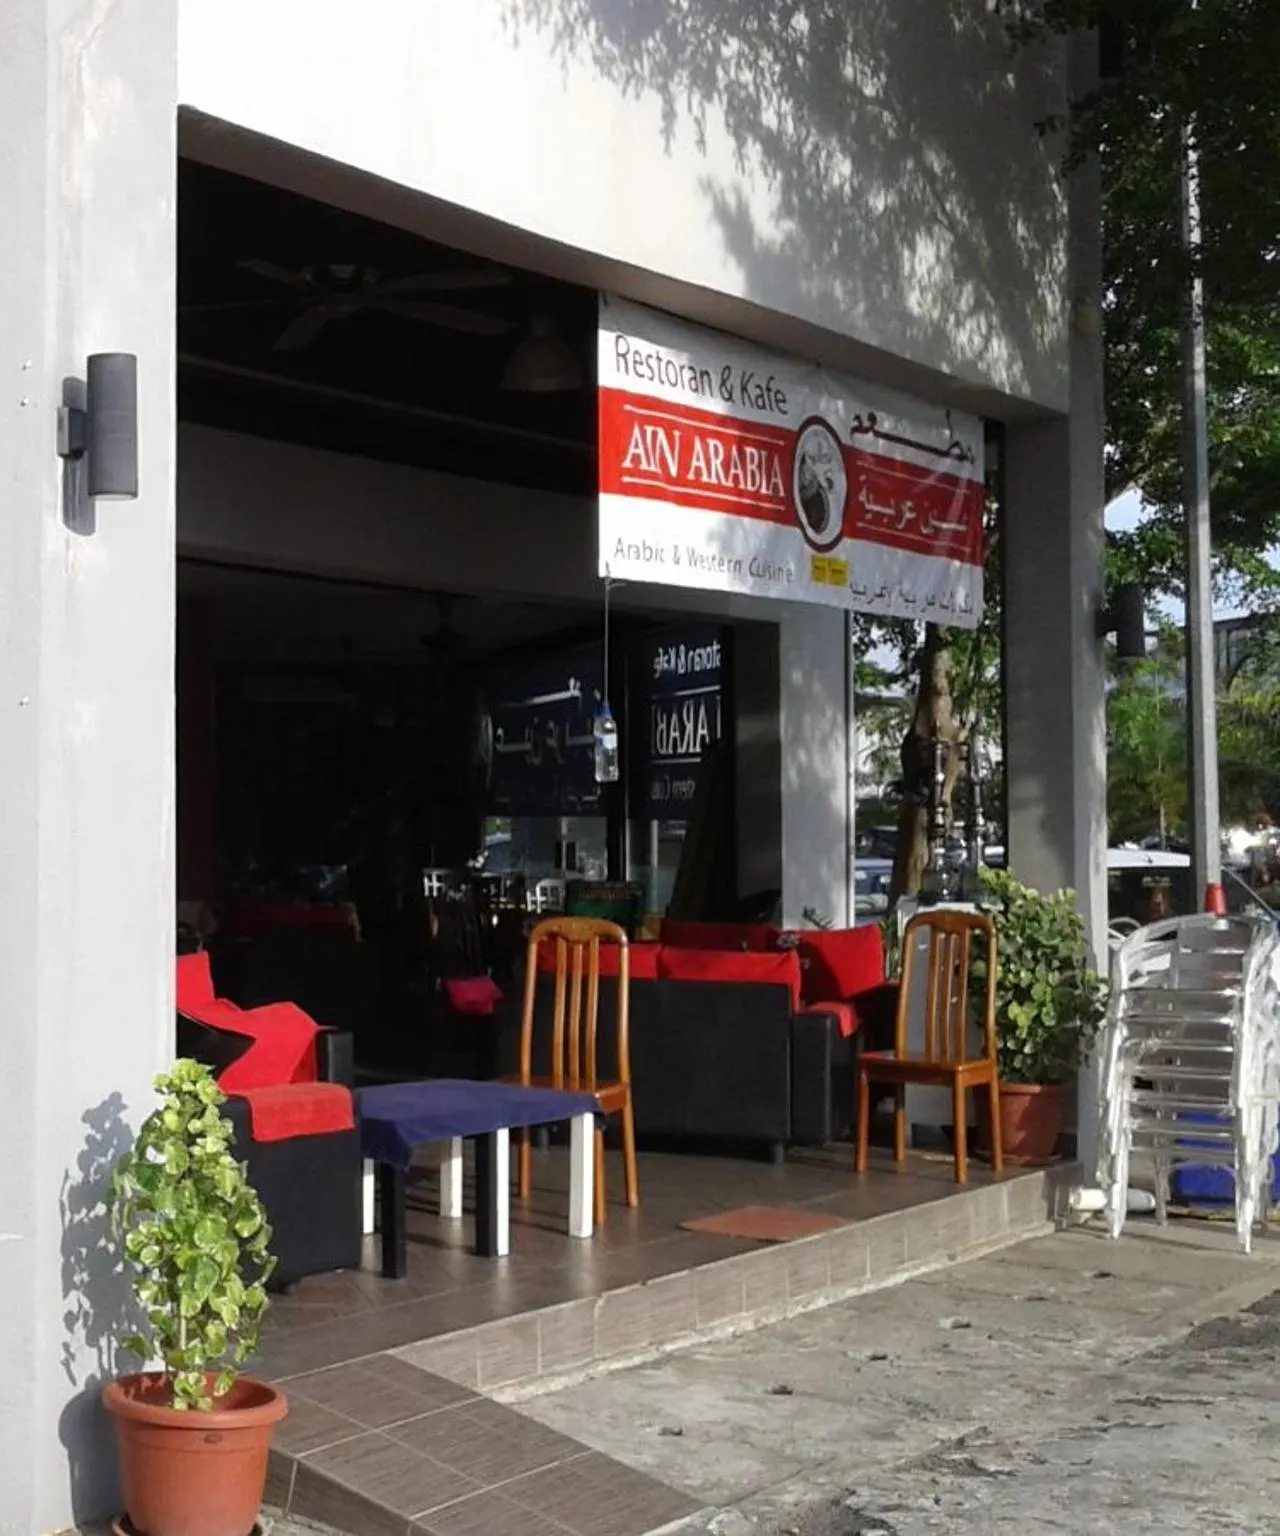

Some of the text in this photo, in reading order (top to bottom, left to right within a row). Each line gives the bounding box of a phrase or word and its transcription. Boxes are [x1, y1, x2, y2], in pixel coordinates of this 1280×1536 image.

[614, 334, 789, 415] Restoran & Kafe
[621, 422, 786, 498] AIN ARABIA
[614, 537, 665, 565] Arabic
[687, 546, 743, 574] Western
[749, 555, 795, 584] Cuisine
